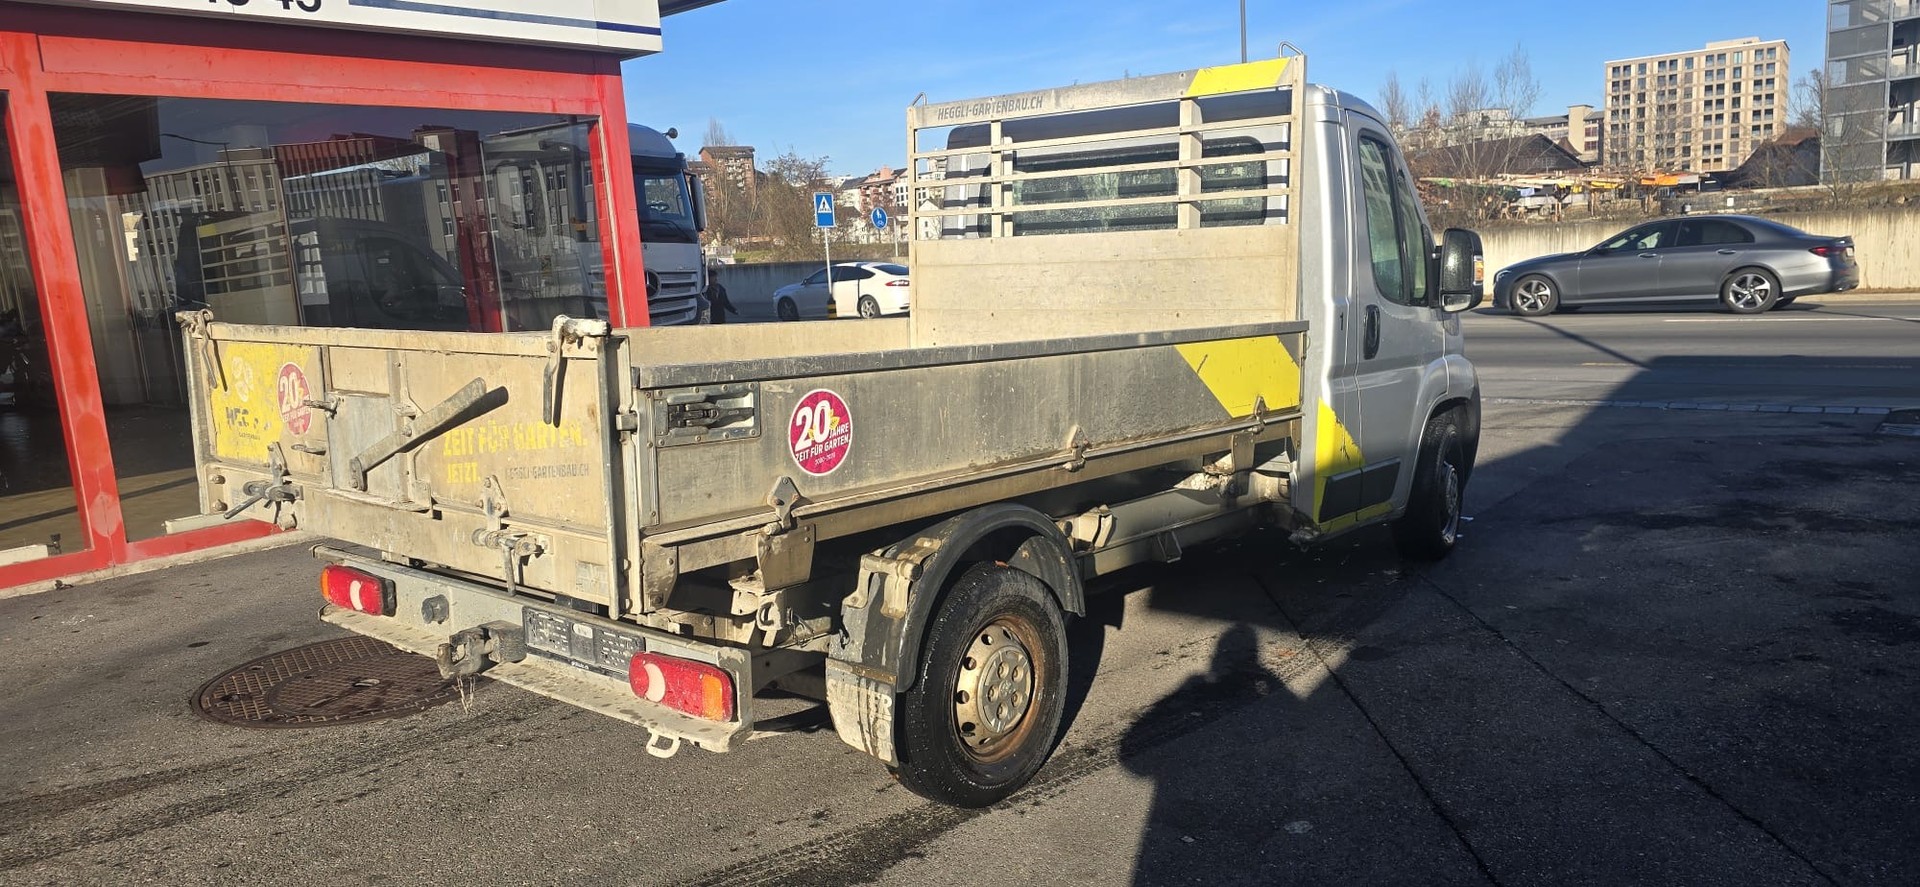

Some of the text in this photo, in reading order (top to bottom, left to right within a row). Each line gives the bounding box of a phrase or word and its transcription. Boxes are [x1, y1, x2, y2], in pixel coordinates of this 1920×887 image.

[938, 96, 1043, 120] HEGGLI-GARTENBAU.CH
[279, 372, 299, 414] 20
[443, 427, 474, 457] ZEIT
[477, 420, 509, 453] FÜR
[795, 400, 832, 452] 20
[829, 422, 850, 439] JAHRE
[795, 448, 811, 462] ZEIT
[824, 434, 850, 452] GARTEN
